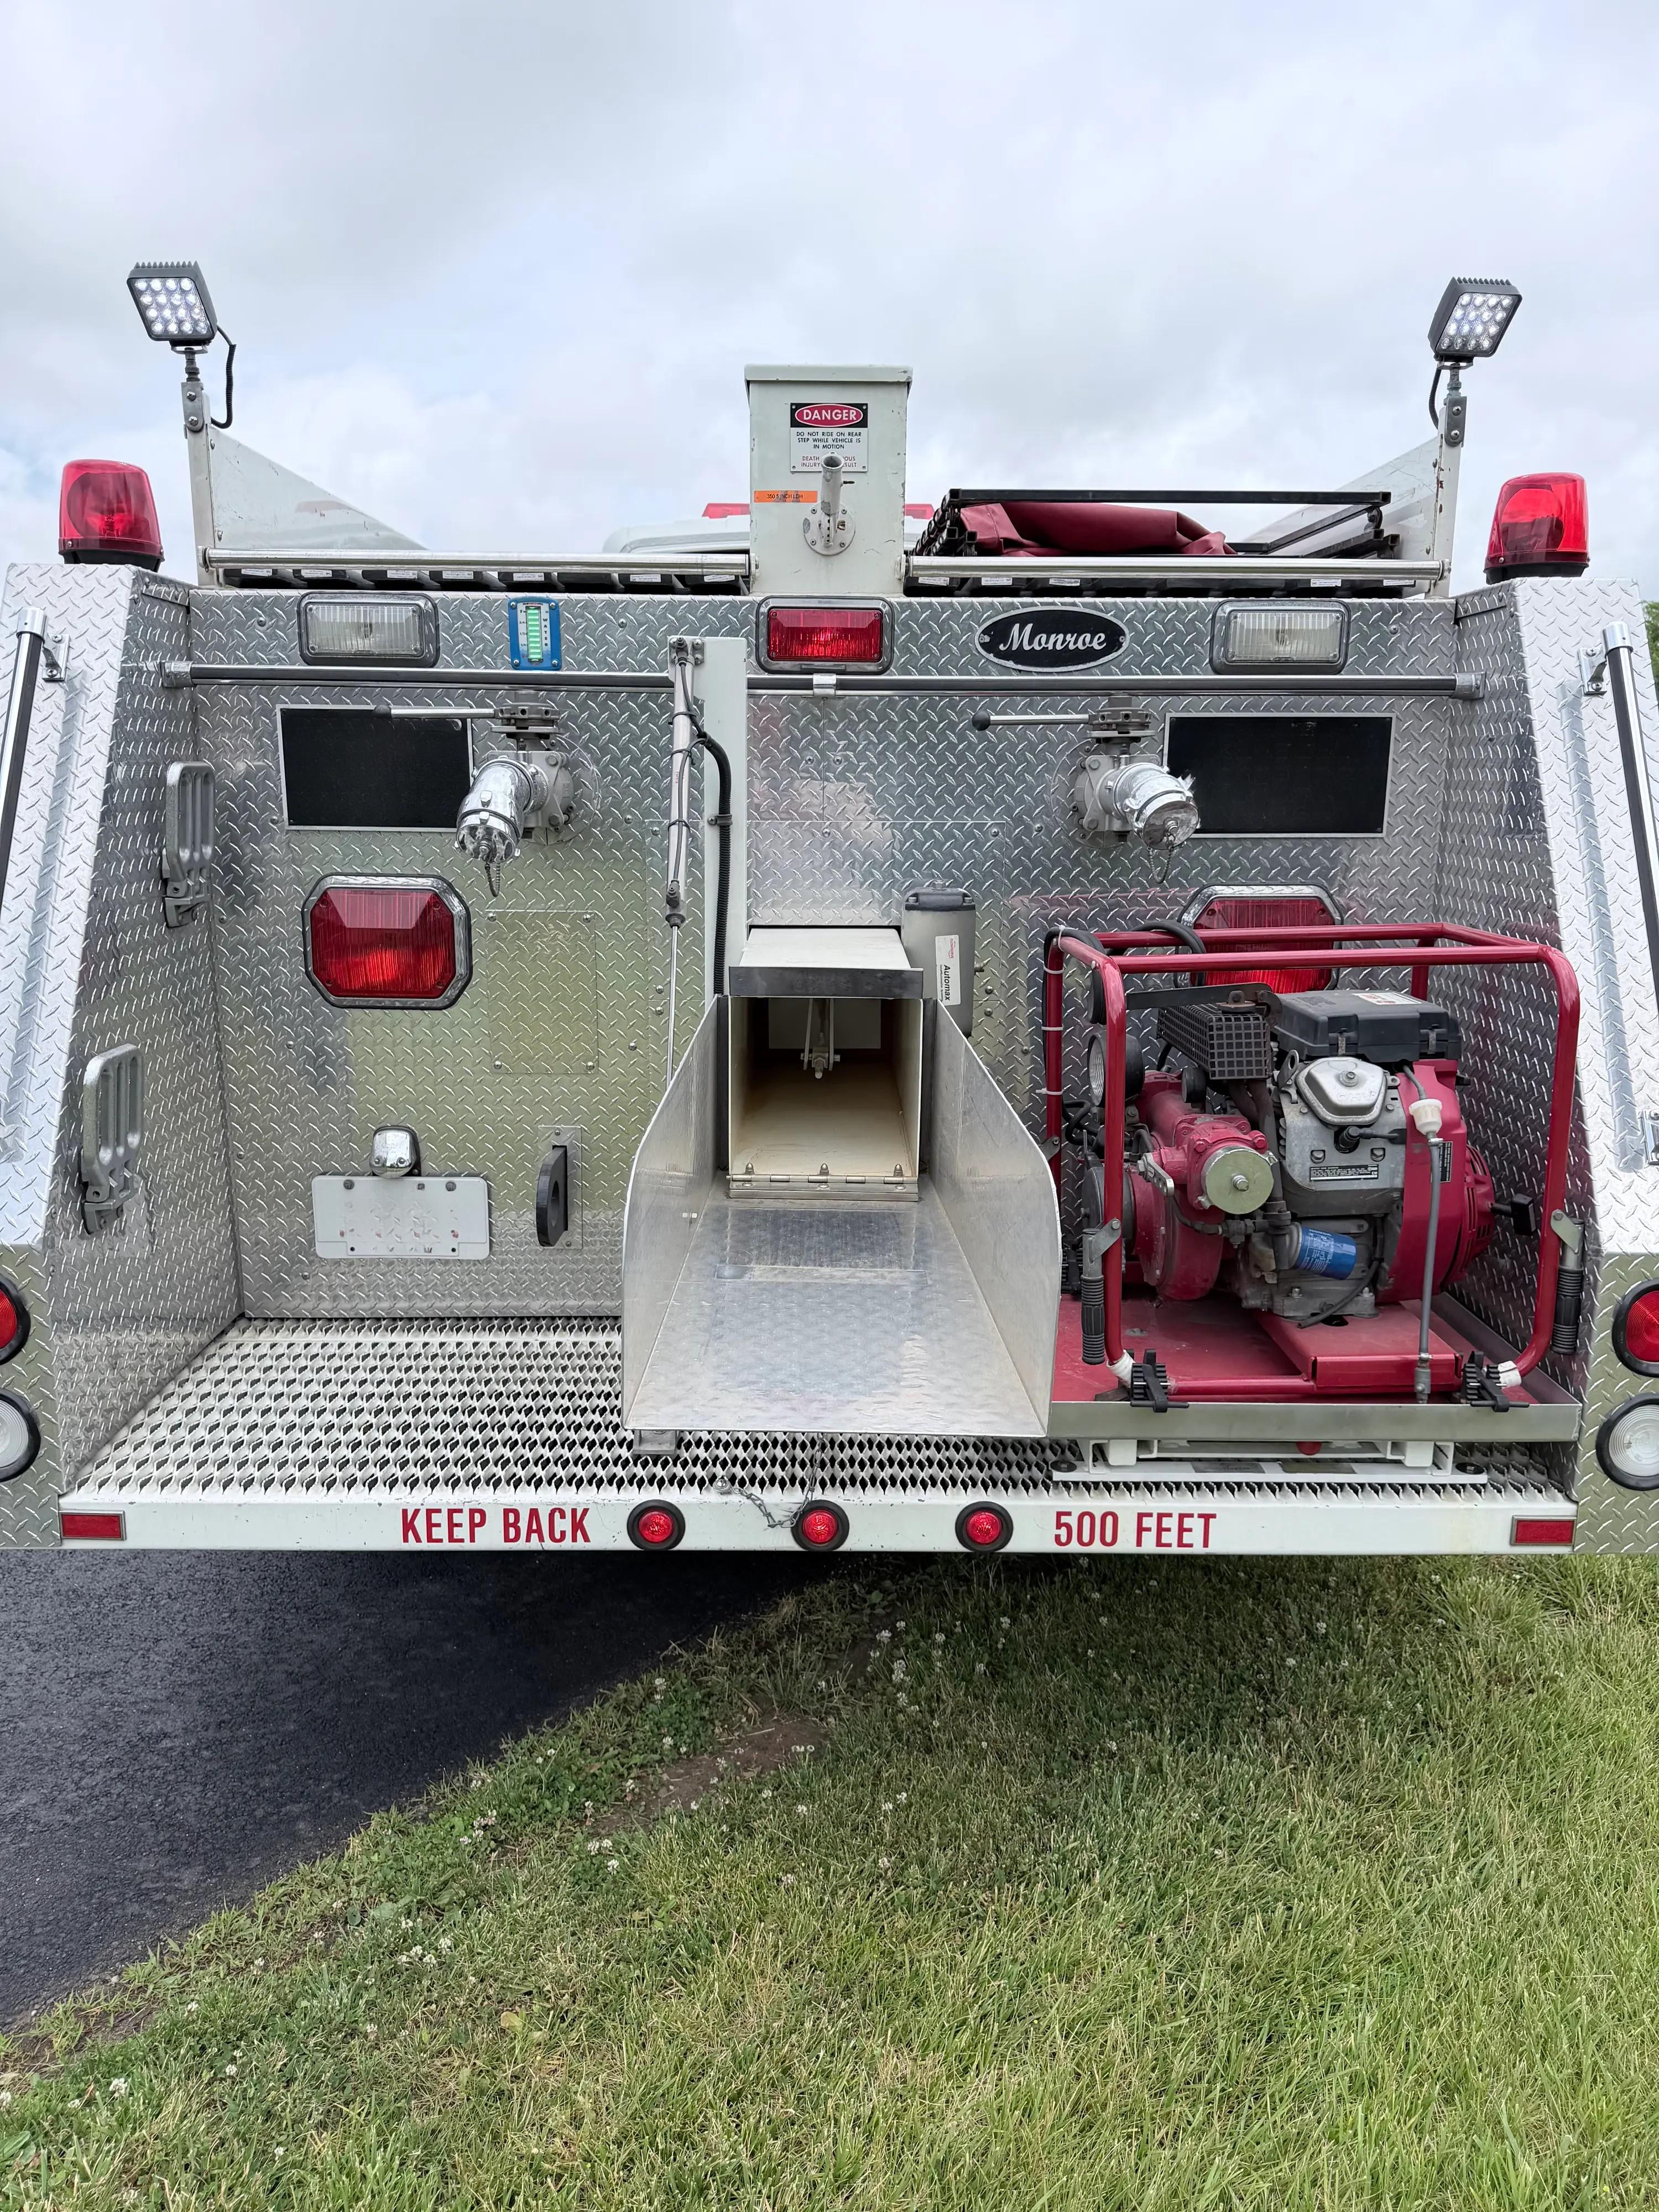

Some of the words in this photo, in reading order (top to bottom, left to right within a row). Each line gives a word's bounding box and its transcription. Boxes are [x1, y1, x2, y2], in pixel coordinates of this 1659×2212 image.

[803, 409, 857, 420] DANGER
[999, 623, 1107, 651] Monroe
[401, 1507, 487, 1543] KEEP
[502, 1507, 591, 1543] BACK
[1054, 1510, 1119, 1547] 500
[1135, 1512, 1217, 1548] FEET
